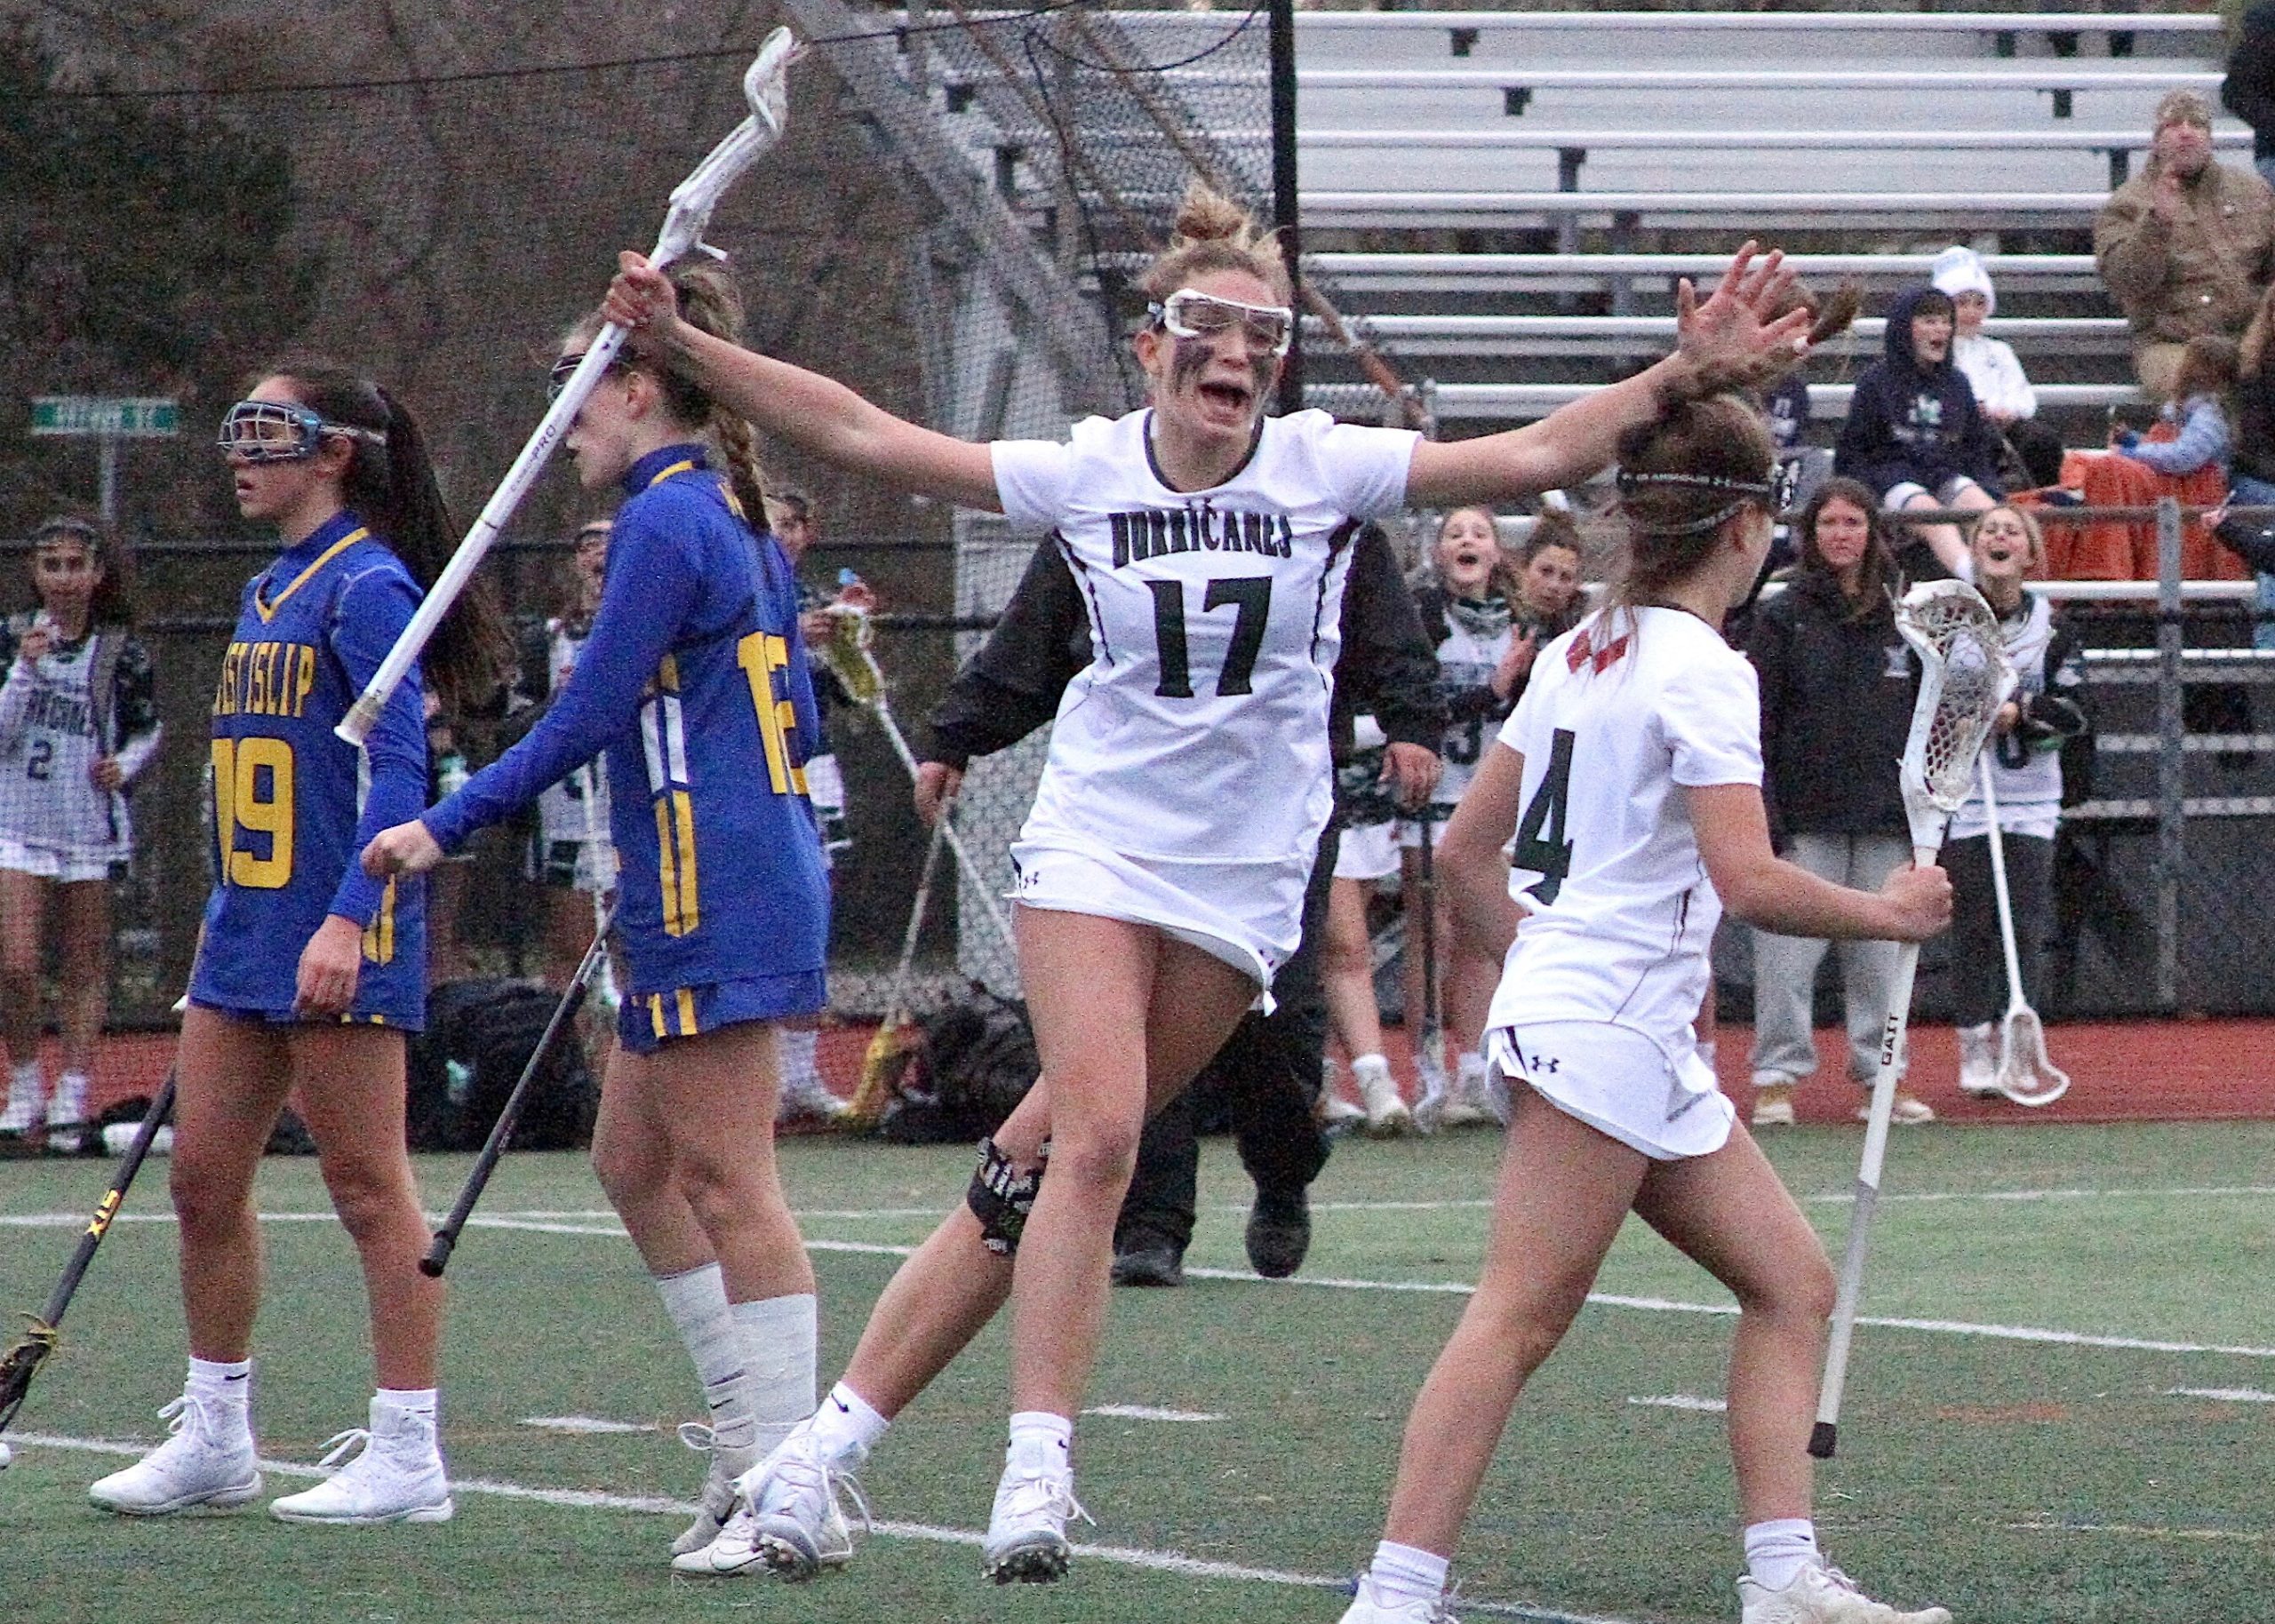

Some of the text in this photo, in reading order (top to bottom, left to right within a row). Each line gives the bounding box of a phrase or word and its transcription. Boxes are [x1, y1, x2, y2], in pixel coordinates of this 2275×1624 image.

[1108, 509, 1293, 570] HURRICANES
[1142, 576, 1273, 698] 17
[244, 641, 316, 719] ISLIP
[28, 738, 52, 780] 2
[211, 735, 294, 889] 19
[1510, 727, 1576, 906] 4
[1880, 1013, 1900, 1066] GAIT
